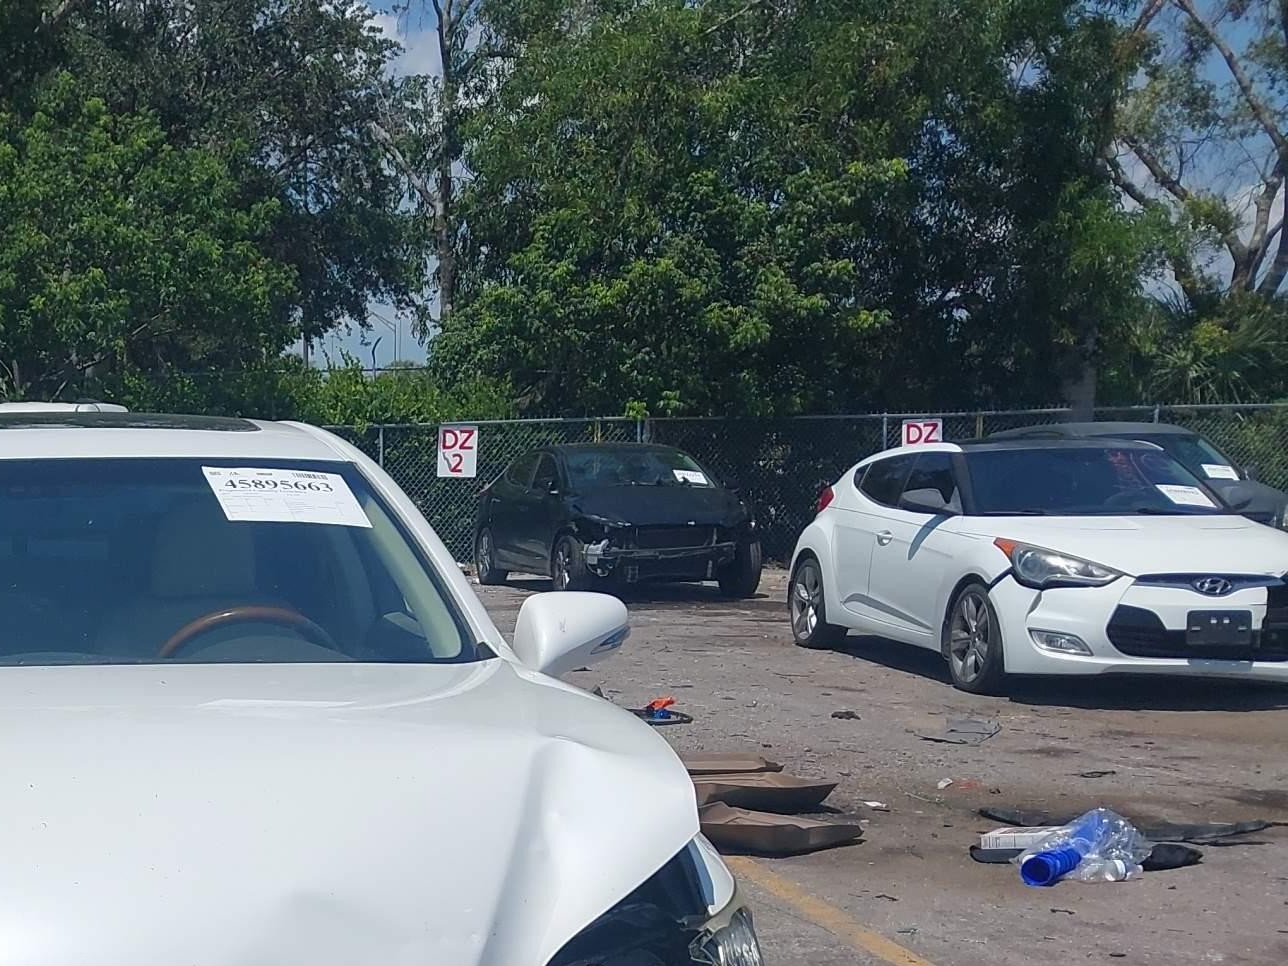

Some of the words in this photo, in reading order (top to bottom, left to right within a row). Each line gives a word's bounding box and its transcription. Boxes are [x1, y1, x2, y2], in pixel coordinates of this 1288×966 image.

[442, 429, 475, 450] DZ
[905, 422, 939, 445] DZ
[450, 453, 463, 473] 2
[223, 478, 335, 493] 45895663
